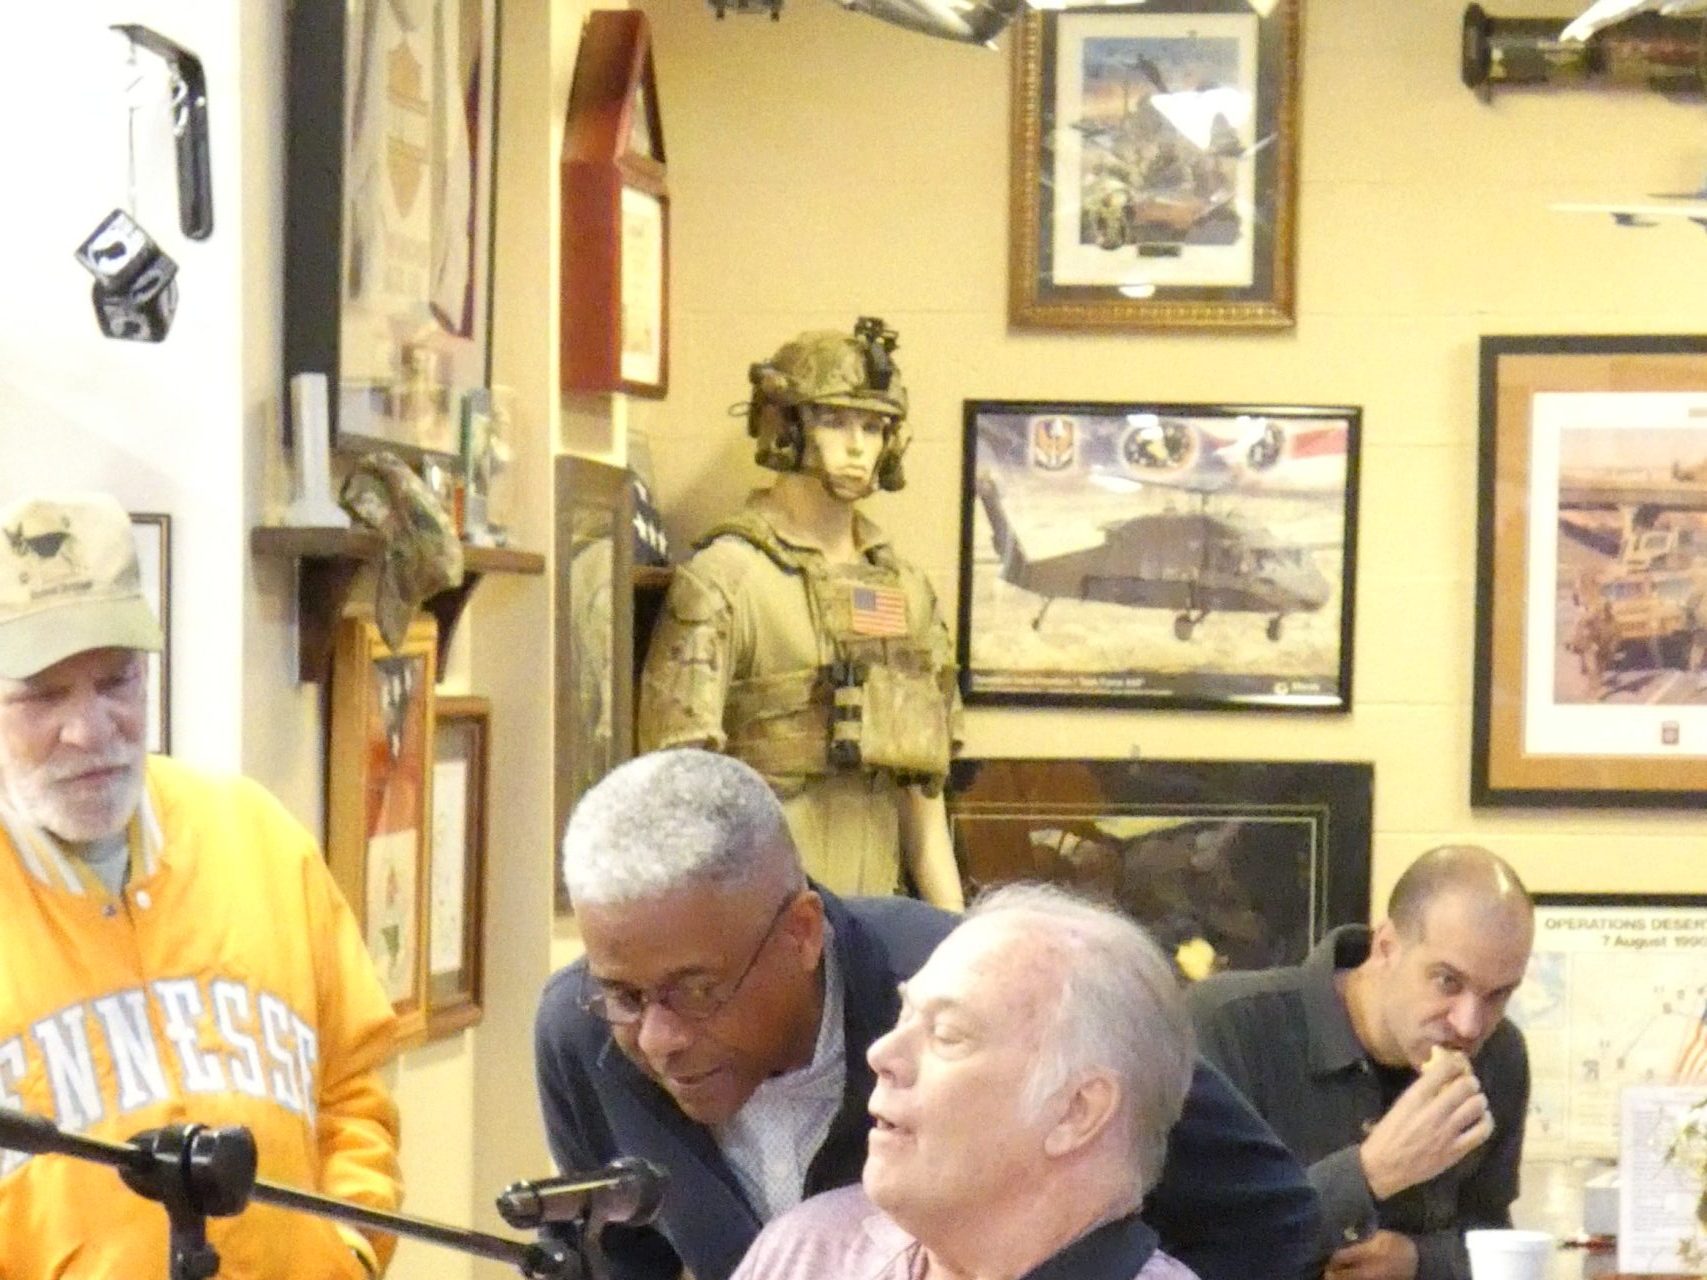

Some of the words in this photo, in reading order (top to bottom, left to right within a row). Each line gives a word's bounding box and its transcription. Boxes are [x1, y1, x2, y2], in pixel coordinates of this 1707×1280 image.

[1544, 917, 1646, 931] OPERATIONS
[1651, 917, 1707, 931] DESER
[1614, 934, 1667, 950] August
